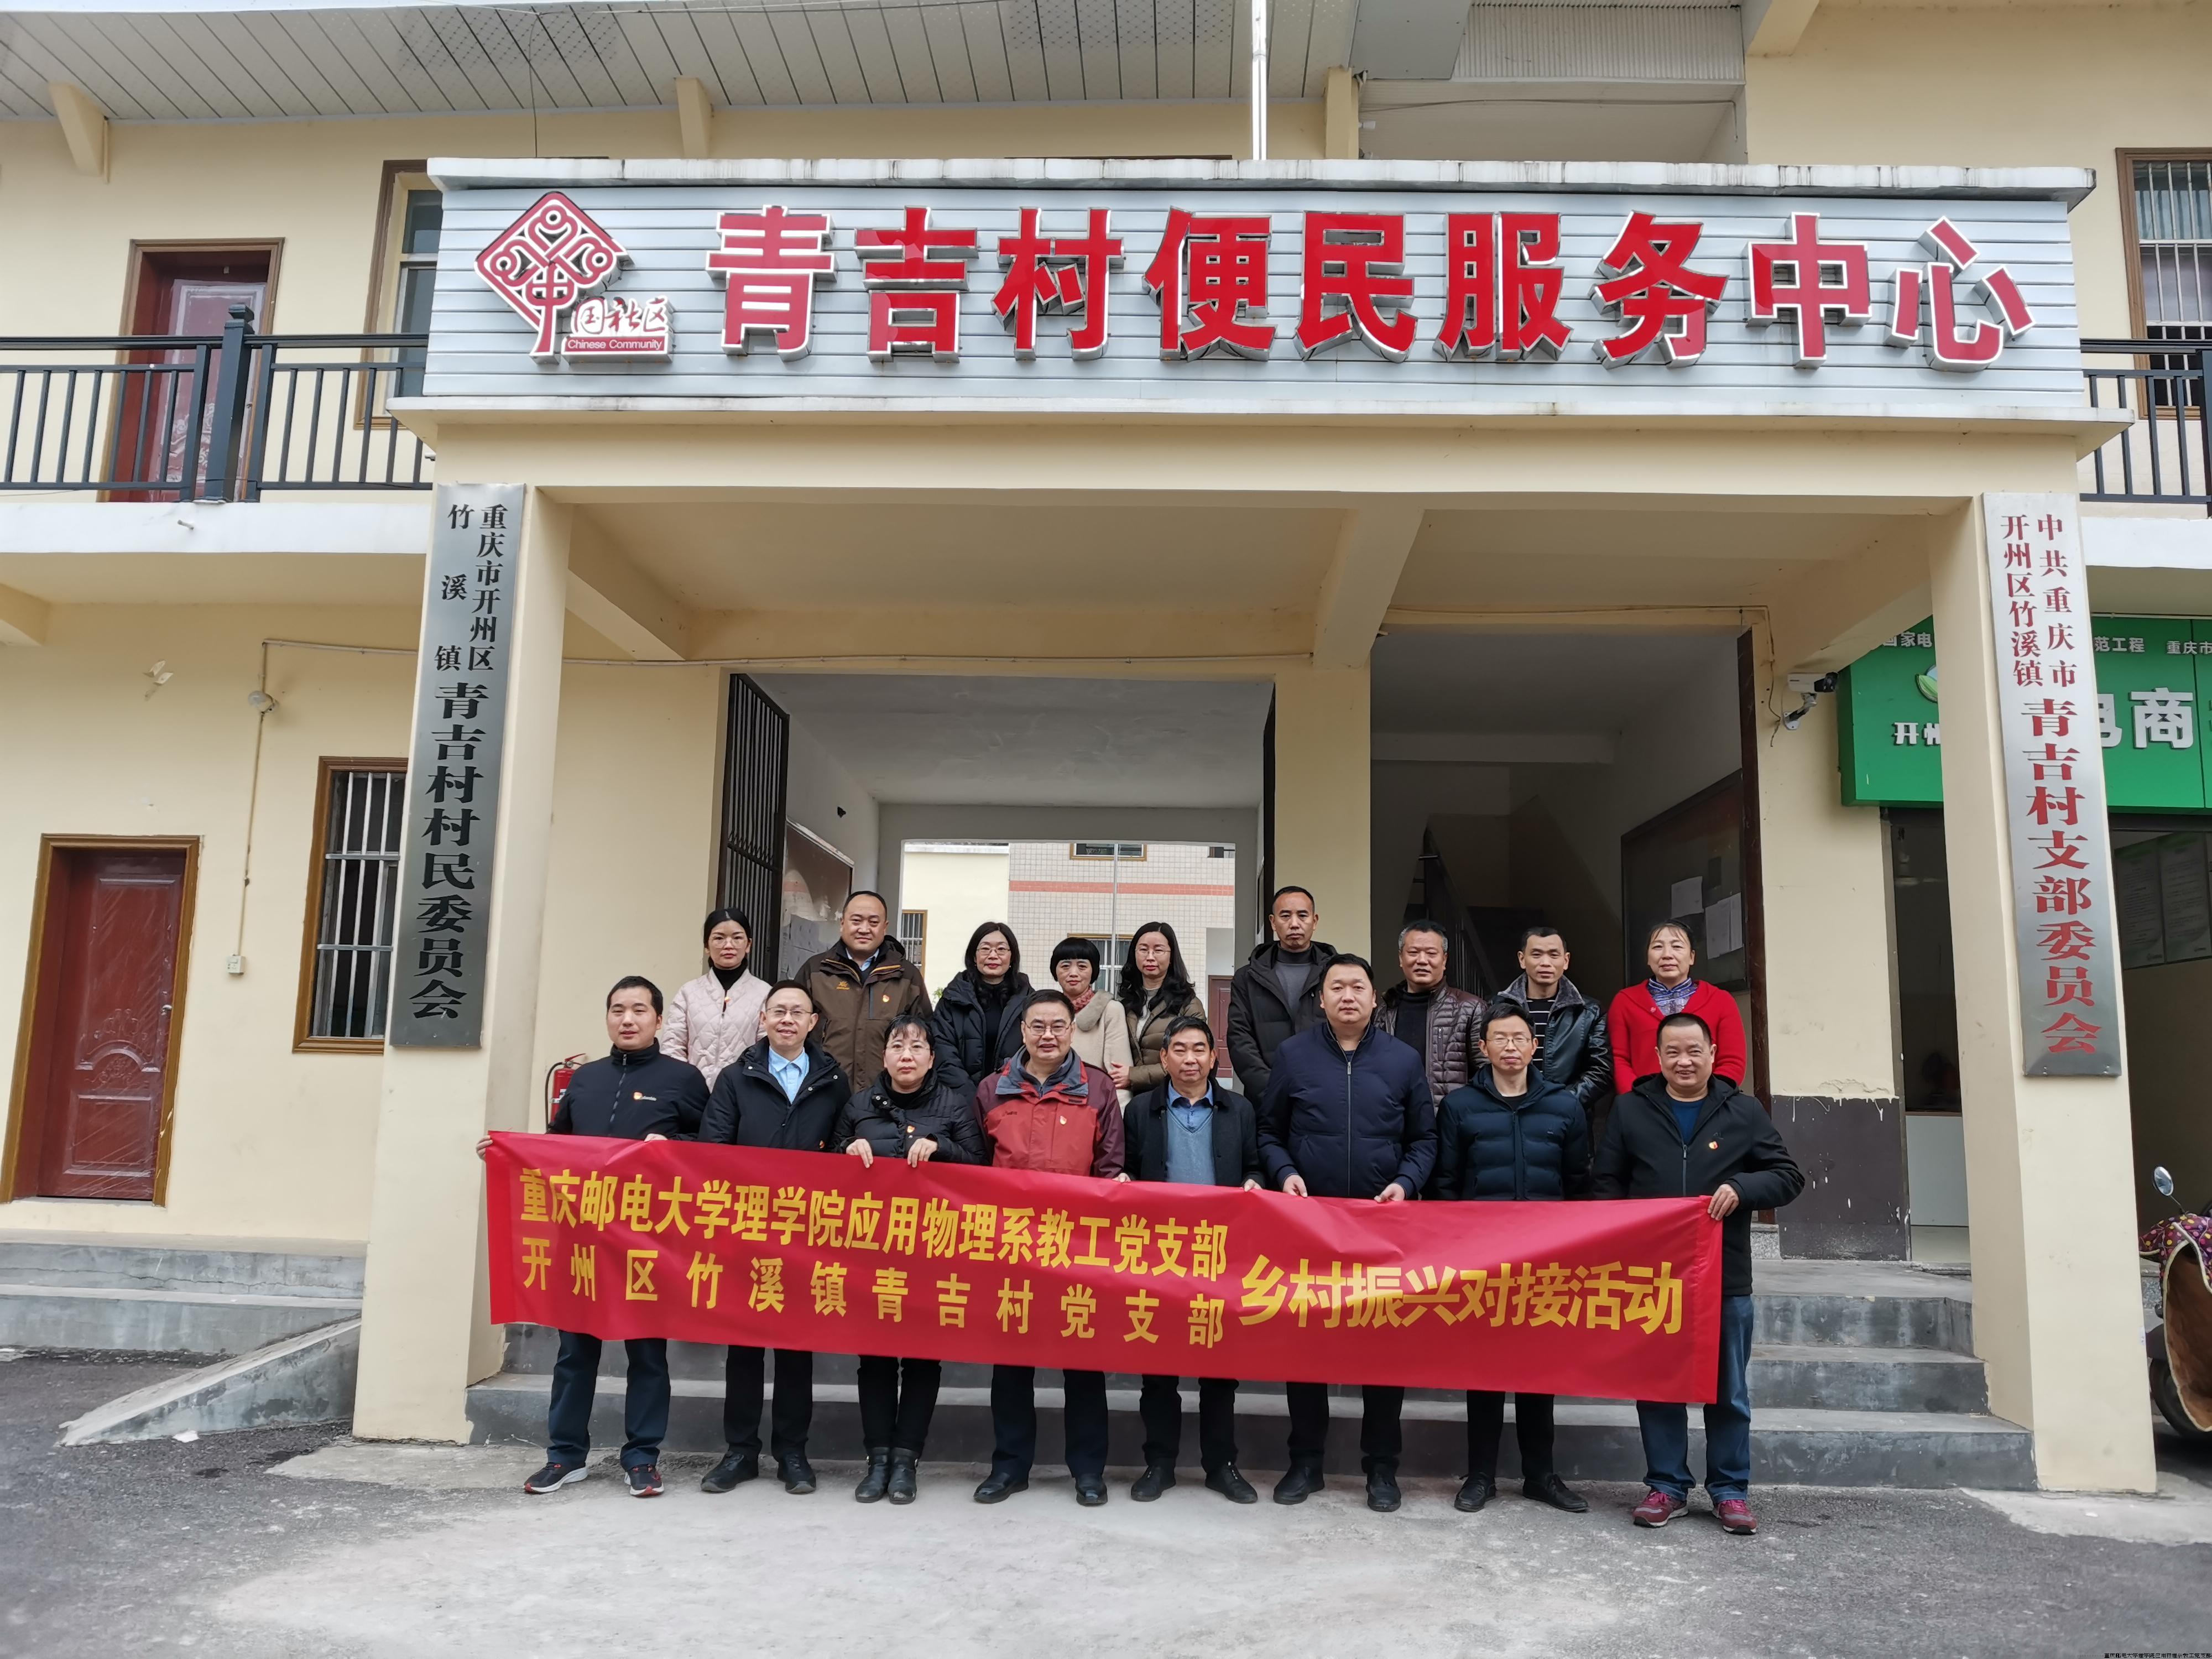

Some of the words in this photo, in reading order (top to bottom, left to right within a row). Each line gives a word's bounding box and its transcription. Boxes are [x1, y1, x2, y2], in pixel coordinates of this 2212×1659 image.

[567, 339, 607, 349] Chinese
[609, 339, 663, 351] Community
[707, 205, 2036, 369] 青吉村便民服务中心
[434, 504, 474, 671] 竹溪镇
[468, 504, 509, 671] 重庆市开州区
[2000, 514, 2043, 687] 开州区竹溪镇
[2038, 514, 2077, 687] 中共重庆市
[2167, 640, 2212, 655] 重庆市
[409, 682, 489, 1019] 青吉村村民委员会
[2021, 698, 2101, 1054] 青吉村支部委员会
[520, 1168, 1228, 1282] 重庆邮电大学理学院应用物理系教工党支部
[521, 1237, 1225, 1349] 开州区竹溪镇青吉村党支部
[1239, 1254, 1682, 1335] 乡村振兴对接活动
